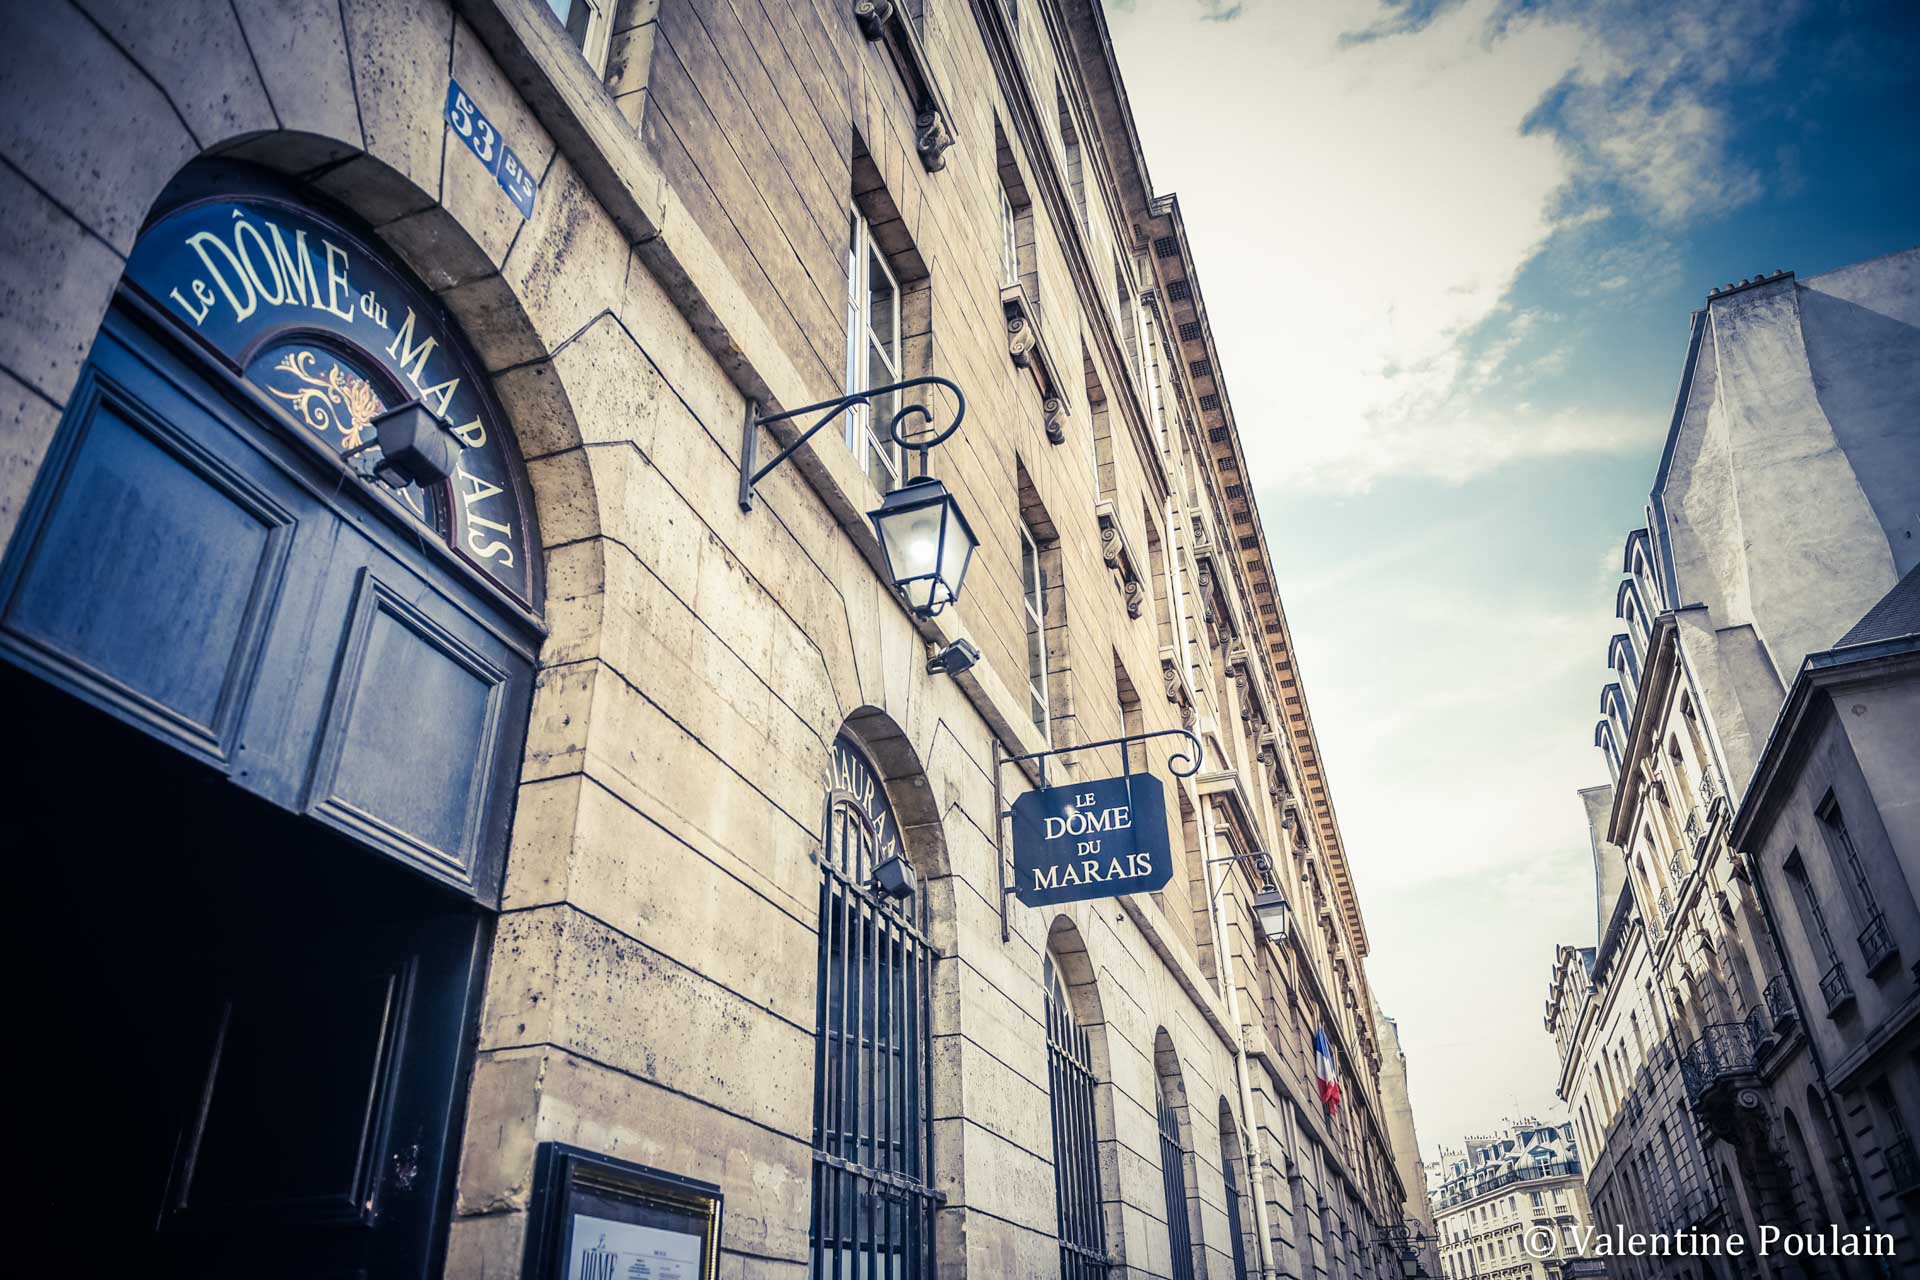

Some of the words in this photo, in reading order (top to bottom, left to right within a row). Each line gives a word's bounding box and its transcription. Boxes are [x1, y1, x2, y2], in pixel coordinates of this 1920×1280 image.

[450, 91, 495, 162] 53
[505, 154, 533, 198] BIS
[185, 208, 354, 323] DÔME
[169, 278, 216, 326] Le
[359, 291, 388, 329] du
[1075, 792, 1096, 808] LE
[1044, 806, 1132, 840] DÔME
[1077, 840, 1101, 856] DU
[1032, 853, 1153, 891] MARAIS
